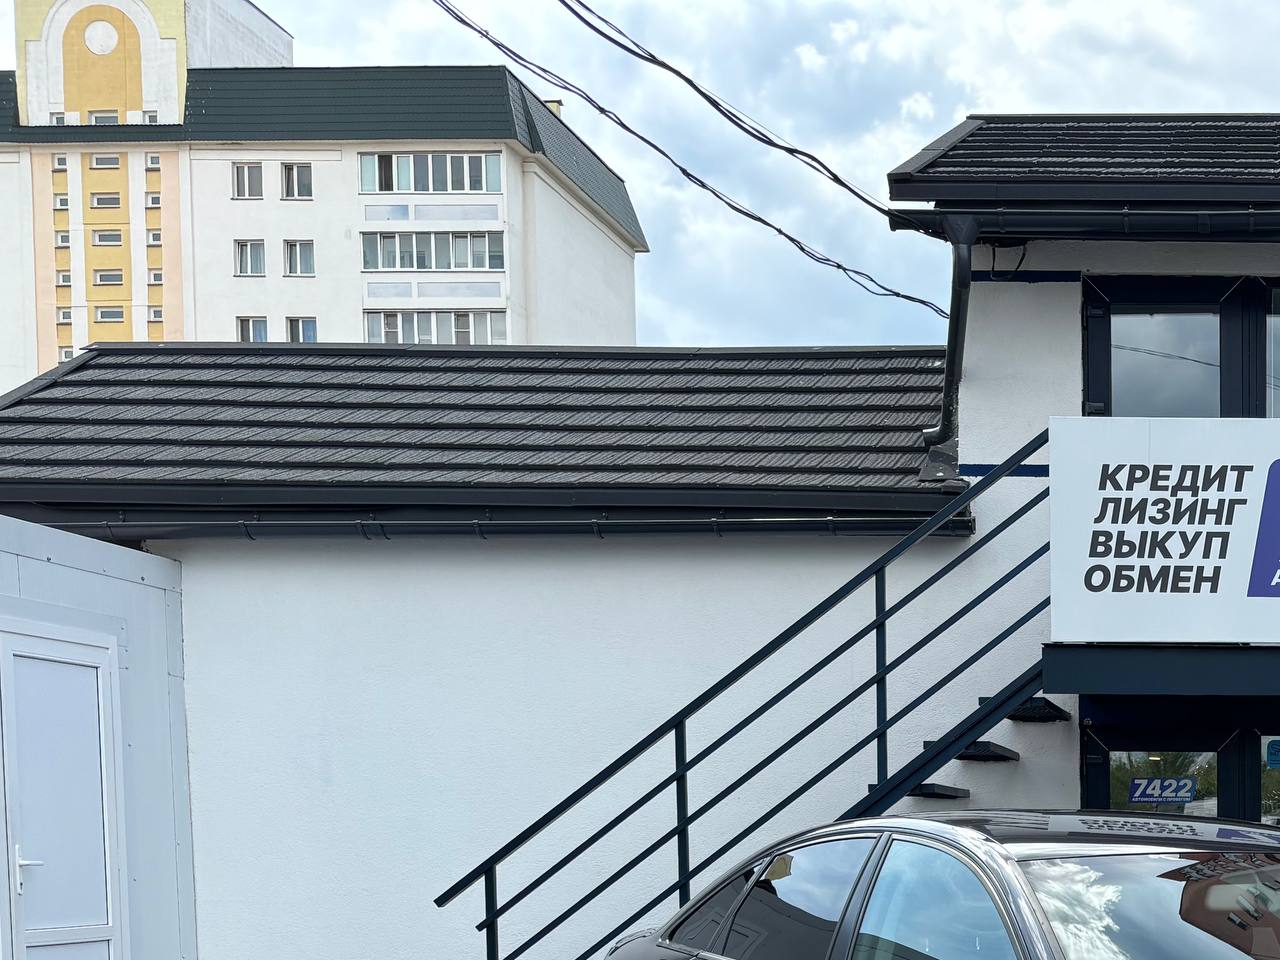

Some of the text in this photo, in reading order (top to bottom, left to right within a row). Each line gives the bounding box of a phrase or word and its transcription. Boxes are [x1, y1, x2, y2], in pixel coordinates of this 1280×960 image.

[1098, 463, 1254, 497] КРЕДИТ
[1093, 497, 1248, 526] ЛИЗИНГ
[1088, 531, 1231, 560] ВЫКУП
[1083, 565, 1222, 594] ОБМЕН
[1133, 779, 1193, 797] 7422
